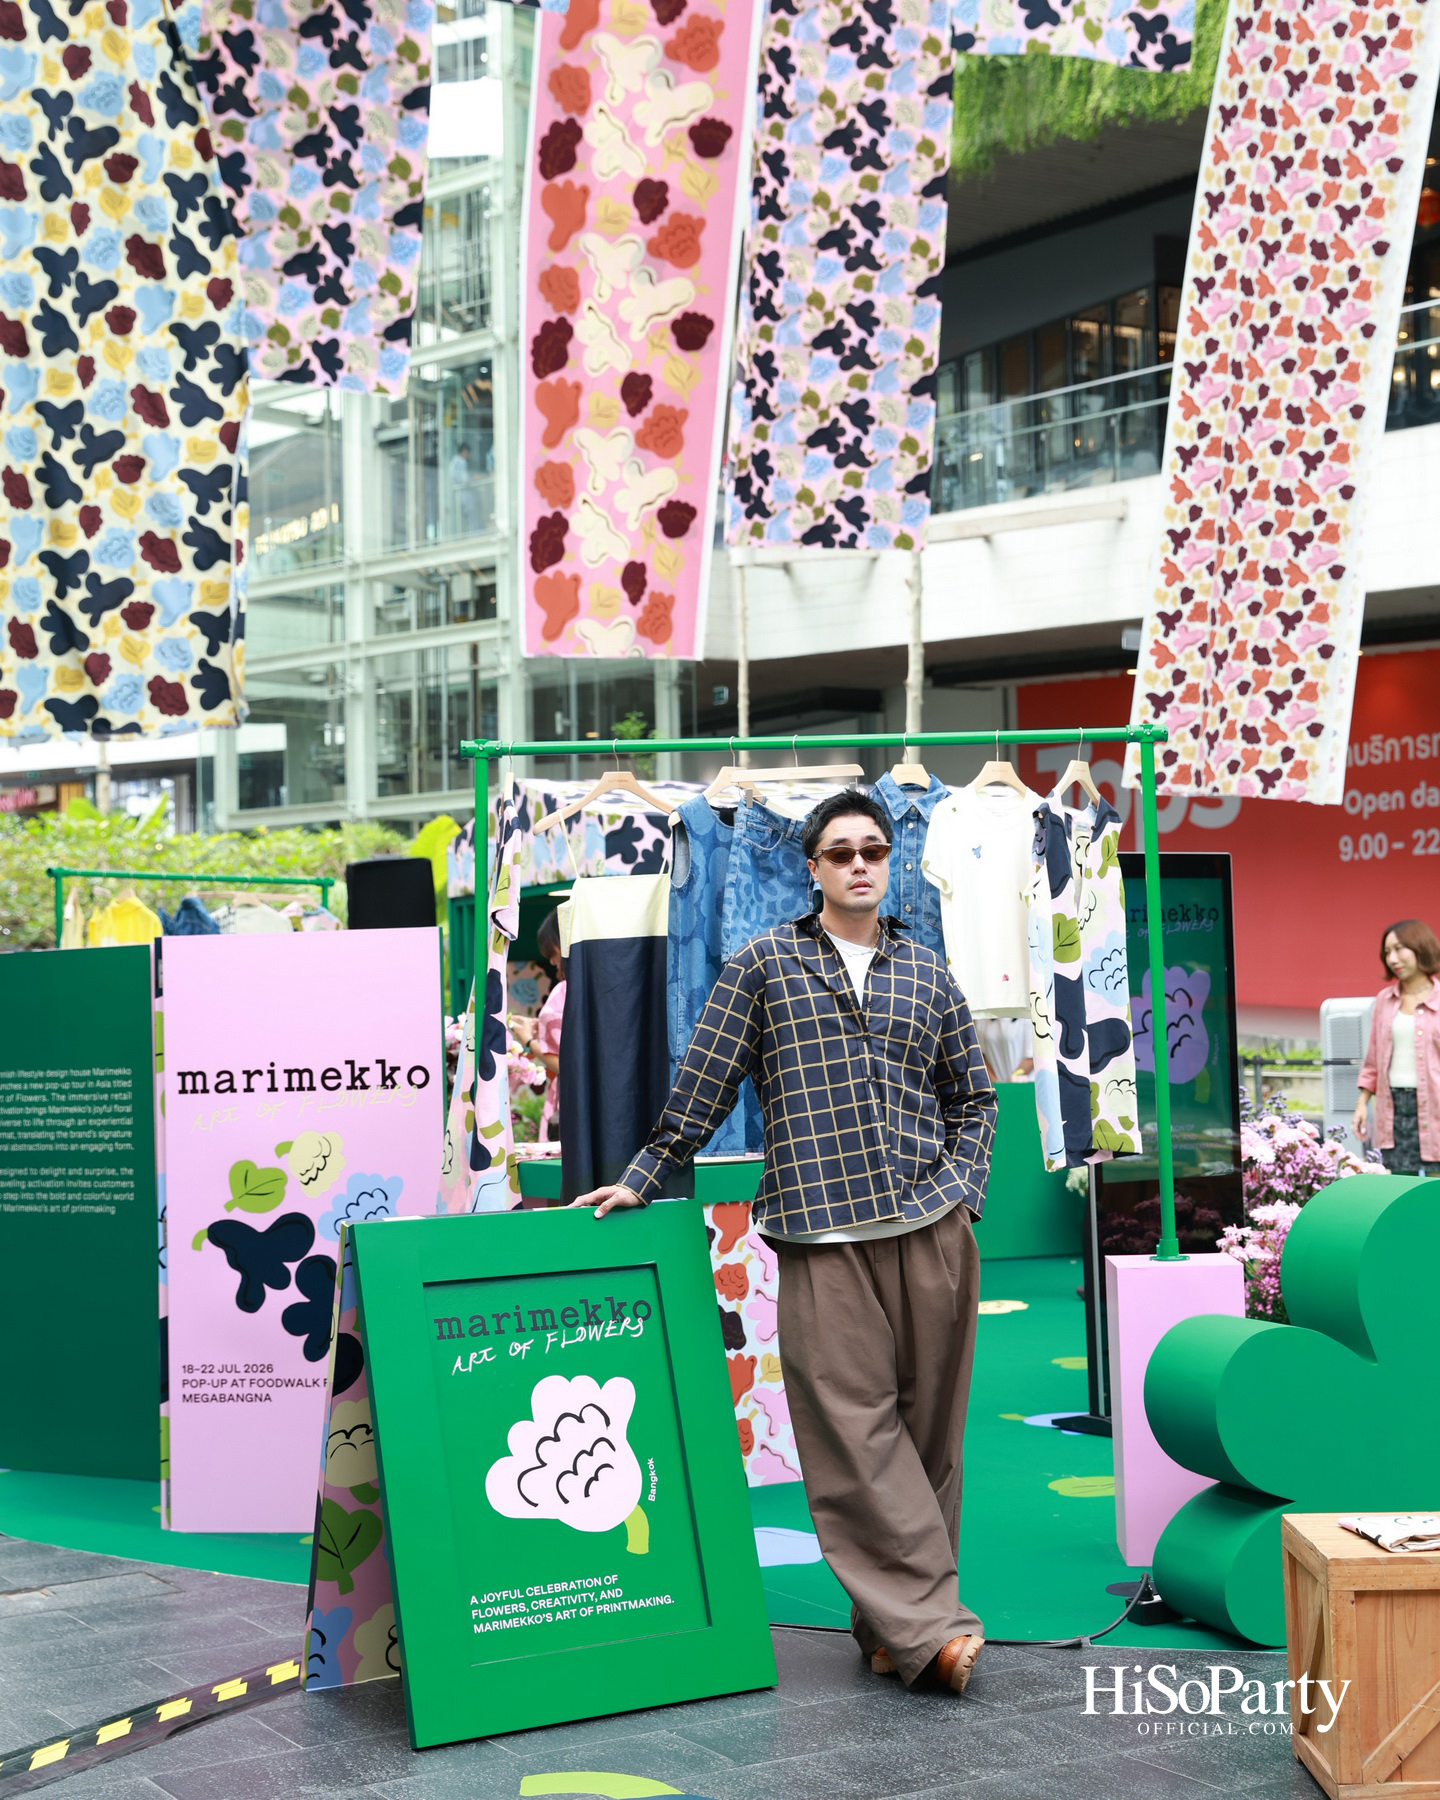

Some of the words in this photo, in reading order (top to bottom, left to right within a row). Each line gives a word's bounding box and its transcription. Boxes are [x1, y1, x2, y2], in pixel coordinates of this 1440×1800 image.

[1344, 788, 1405, 820] Open
[1126, 903, 1219, 923] riekko
[177, 1059, 431, 1094] marimekko
[191, 1106, 241, 1132] ART
[256, 1100, 285, 1122] OF
[298, 1084, 419, 1117] FLOWERS
[434, 1296, 652, 1340] marimekko
[452, 1346, 497, 1375] ART
[508, 1338, 535, 1359] OF
[544, 1316, 644, 1354] FLOWERS
[182, 1378, 227, 1388] POP-UP
[231, 1378, 246, 1388] AT
[249, 1378, 320, 1388] FOODWALK
[218, 1364, 241, 1373] JUL
[244, 1363, 274, 1373] 2026
[182, 1393, 272, 1403] MEGABANGNA
[647, 1457, 659, 1502] Bangkok
[470, 1595, 478, 1605] A
[480, 1588, 524, 1603] JOYFUL
[526, 1578, 602, 1597] CELEBRATION
[604, 1574, 619, 1586] OF
[472, 1603, 530, 1619] FLOWERS,
[530, 1593, 598, 1611] CREATIVITY,
[600, 1588, 623, 1600] AND
[555, 1608, 577, 1621] ART
[579, 1605, 594, 1618] OF
[596, 1594, 675, 1615] PRINTMAKING.
